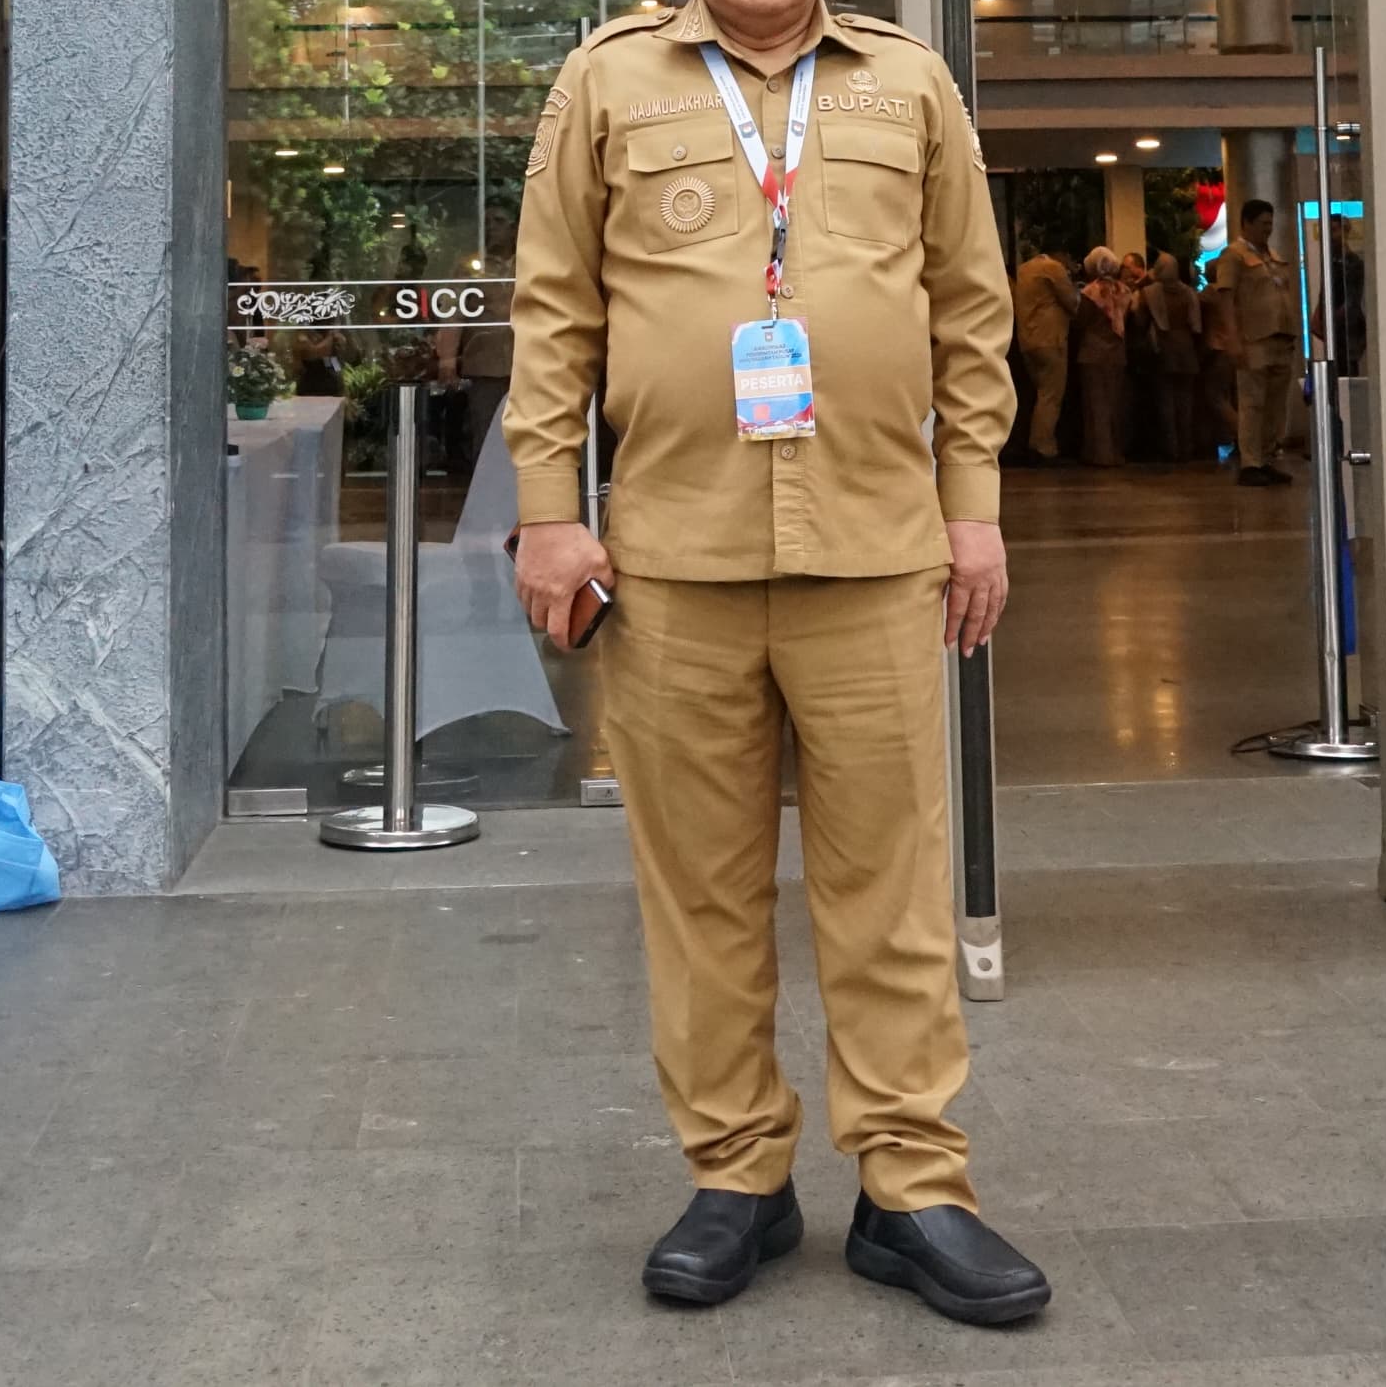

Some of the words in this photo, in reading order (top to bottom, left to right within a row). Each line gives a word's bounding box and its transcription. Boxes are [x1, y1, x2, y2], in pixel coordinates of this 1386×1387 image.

[816, 93, 914, 121] BUPATI
[395, 287, 485, 319] SICC
[740, 372, 805, 392] PESERTA
